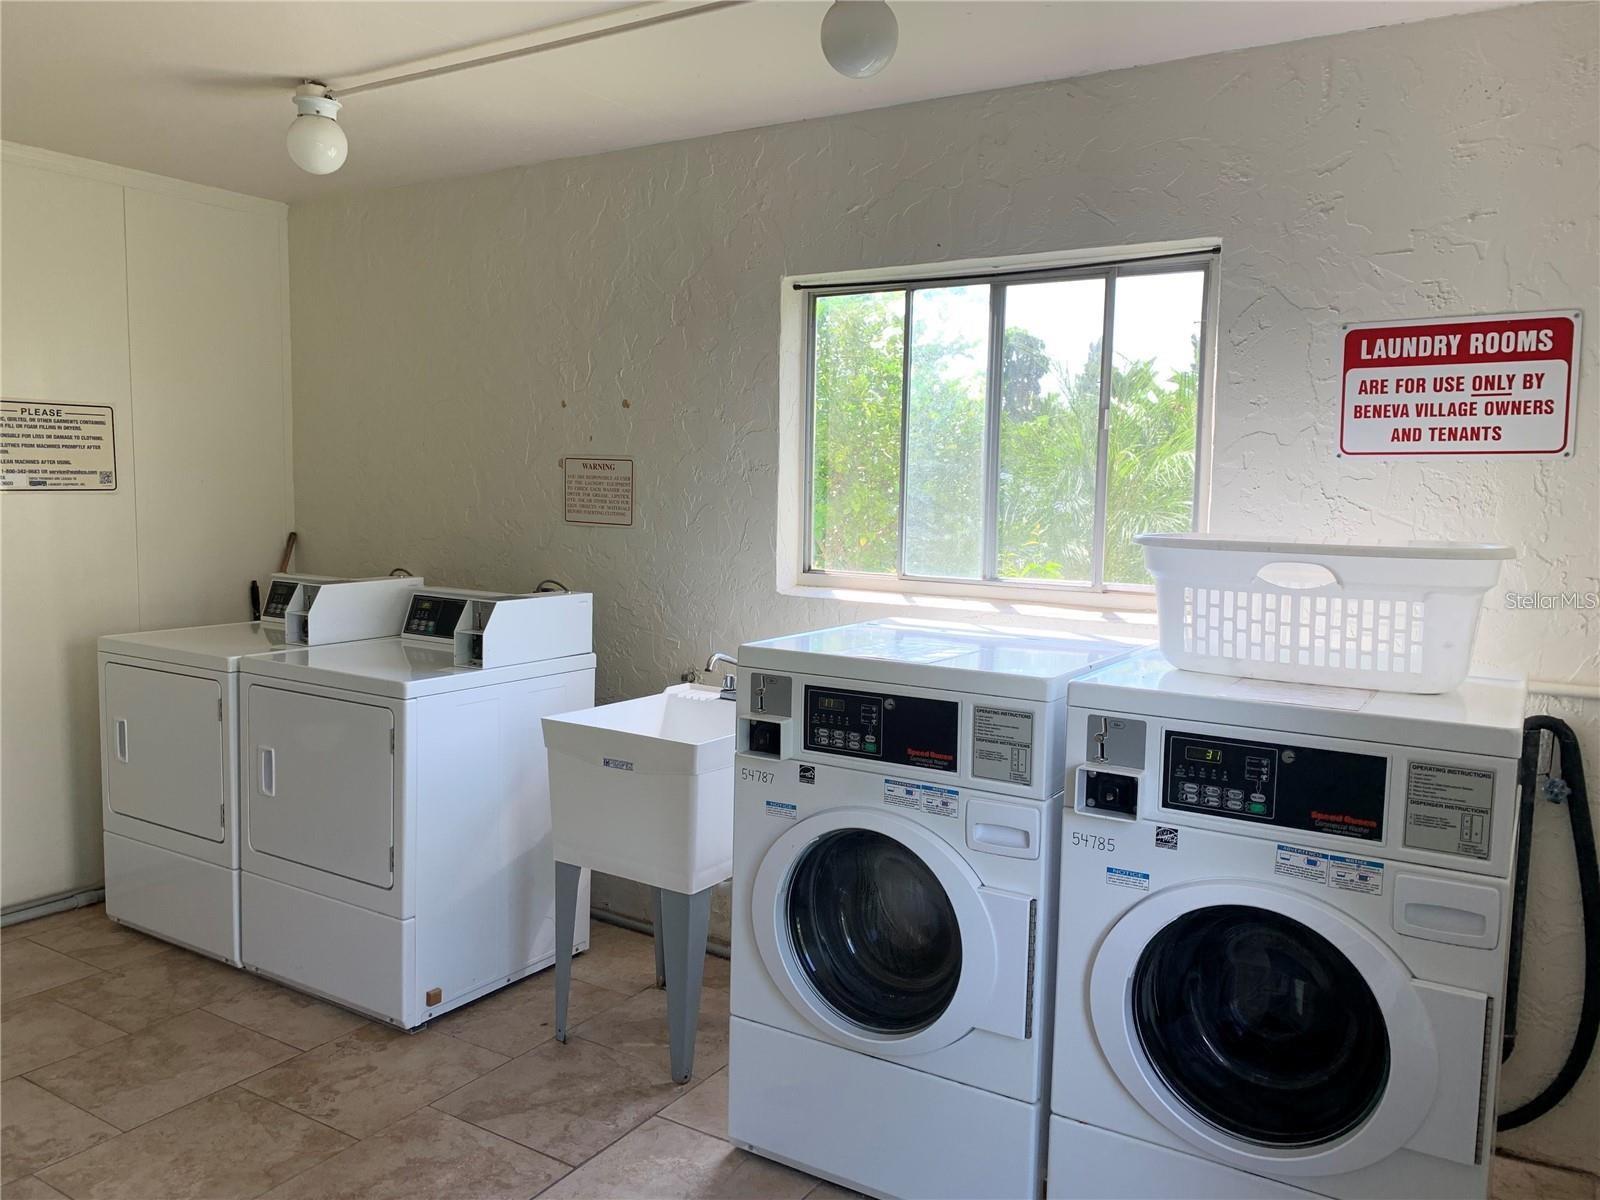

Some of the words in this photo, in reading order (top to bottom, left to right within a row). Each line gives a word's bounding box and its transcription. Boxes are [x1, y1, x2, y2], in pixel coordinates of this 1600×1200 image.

[1360, 334, 1462, 360] LAUNDRY
[1470, 329, 1554, 355] ROOMS
[1358, 379, 1389, 395] ARE
[1396, 377, 1426, 394] FOR
[1433, 376, 1466, 392] USE
[1471, 374, 1516, 392] ONLY
[1522, 372, 1546, 390] BY
[20, 408, 62, 417] PLEASE
[1354, 403, 1410, 419] BENEVA
[1416, 402, 1478, 418] VILLAGE
[1484, 400, 1555, 416] OWNERS
[1391, 427, 1422, 442] AND
[1428, 426, 1502, 442] TENANTS
[1000, 712, 1032, 720] INSTRUCTIONS
[742, 768, 774, 784] 54787
[1412, 764, 1446, 774] OPERATING
[1446, 768, 1492, 779] INSTRUCTIONS
[1410, 800, 1444, 810] DISPENSER
[1444, 804, 1489, 815] INSTRUCTIONS
[1072, 832, 1116, 852] 54785
[1112, 868, 1142, 878] NOTICE
